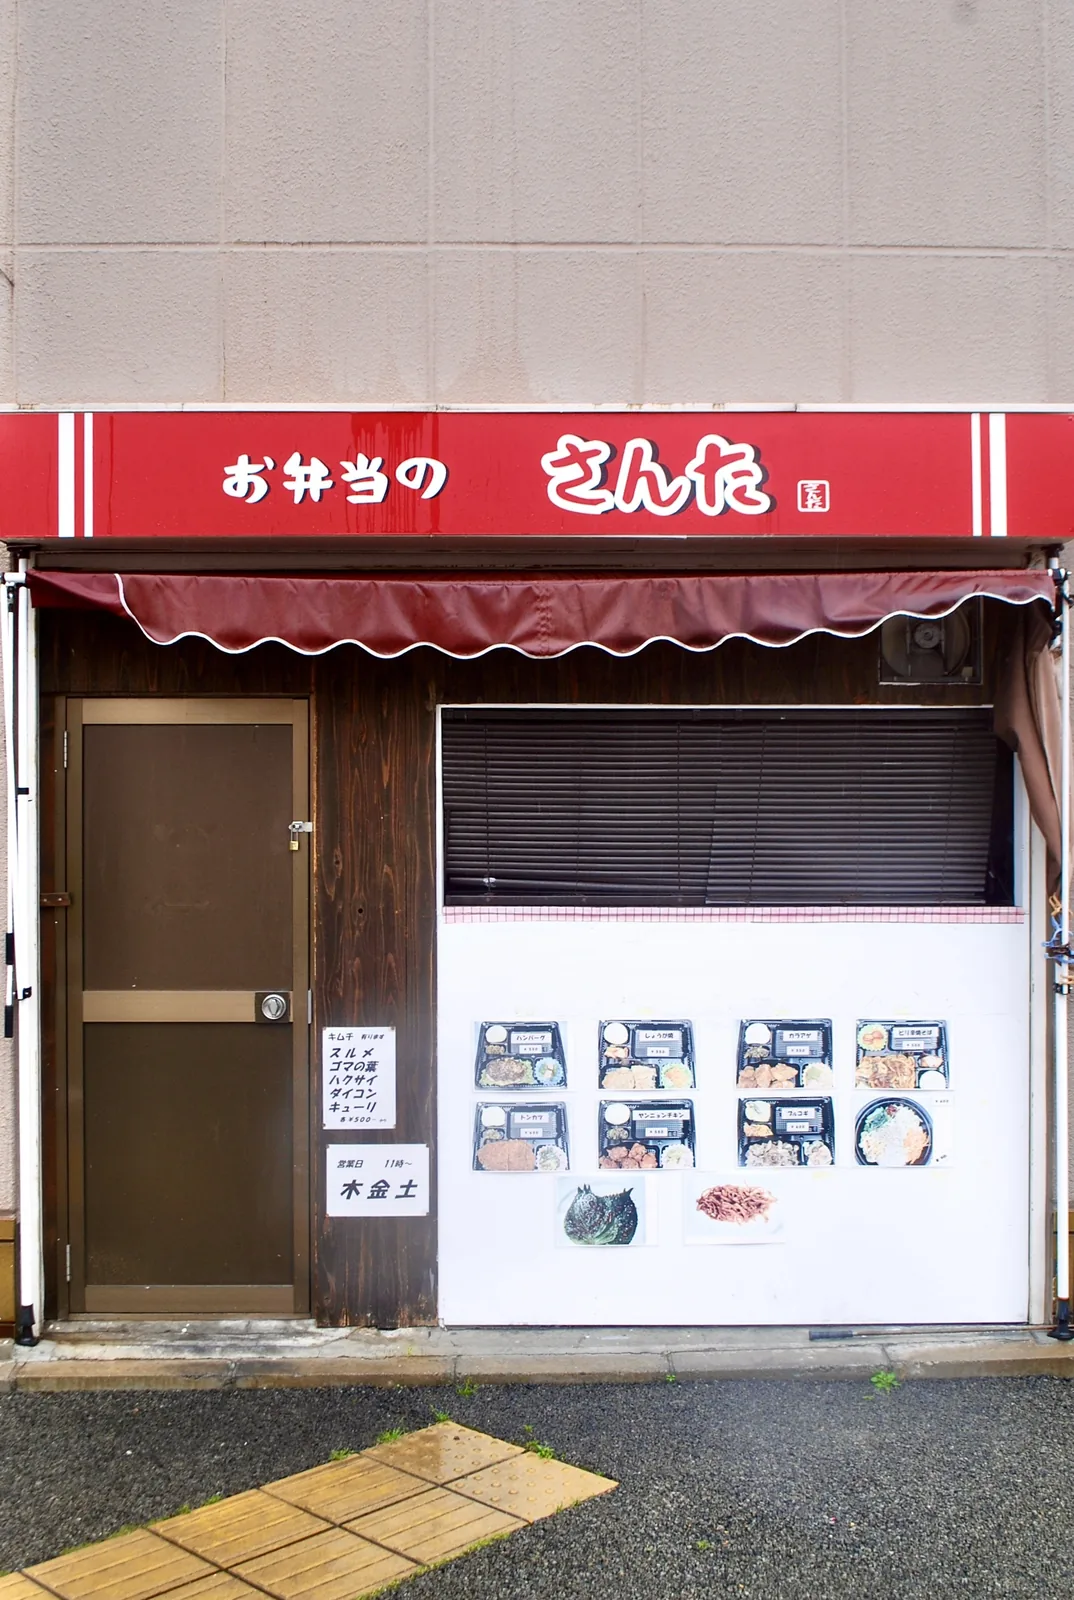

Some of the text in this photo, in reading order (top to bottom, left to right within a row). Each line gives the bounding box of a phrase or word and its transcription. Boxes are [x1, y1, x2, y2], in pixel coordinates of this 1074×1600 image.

[222, 434, 774, 517] お弁当の さんた
[328, 1032, 354, 1041] キムチ
[515, 1033, 546, 1041] ハンバーグ
[788, 1032, 813, 1040] カラアゲ
[329, 1047, 375, 1059] スルメ
[329, 1060, 380, 1073] ゴマの葉
[328, 1074, 379, 1086] ハクサイ
[329, 1087, 378, 1100] ダイコン
[328, 1101, 378, 1114] キューリ
[520, 1112, 544, 1121] トンカツ
[336, 1159, 365, 1169] 営業日
[340, 1179, 418, 1200] 木金土
